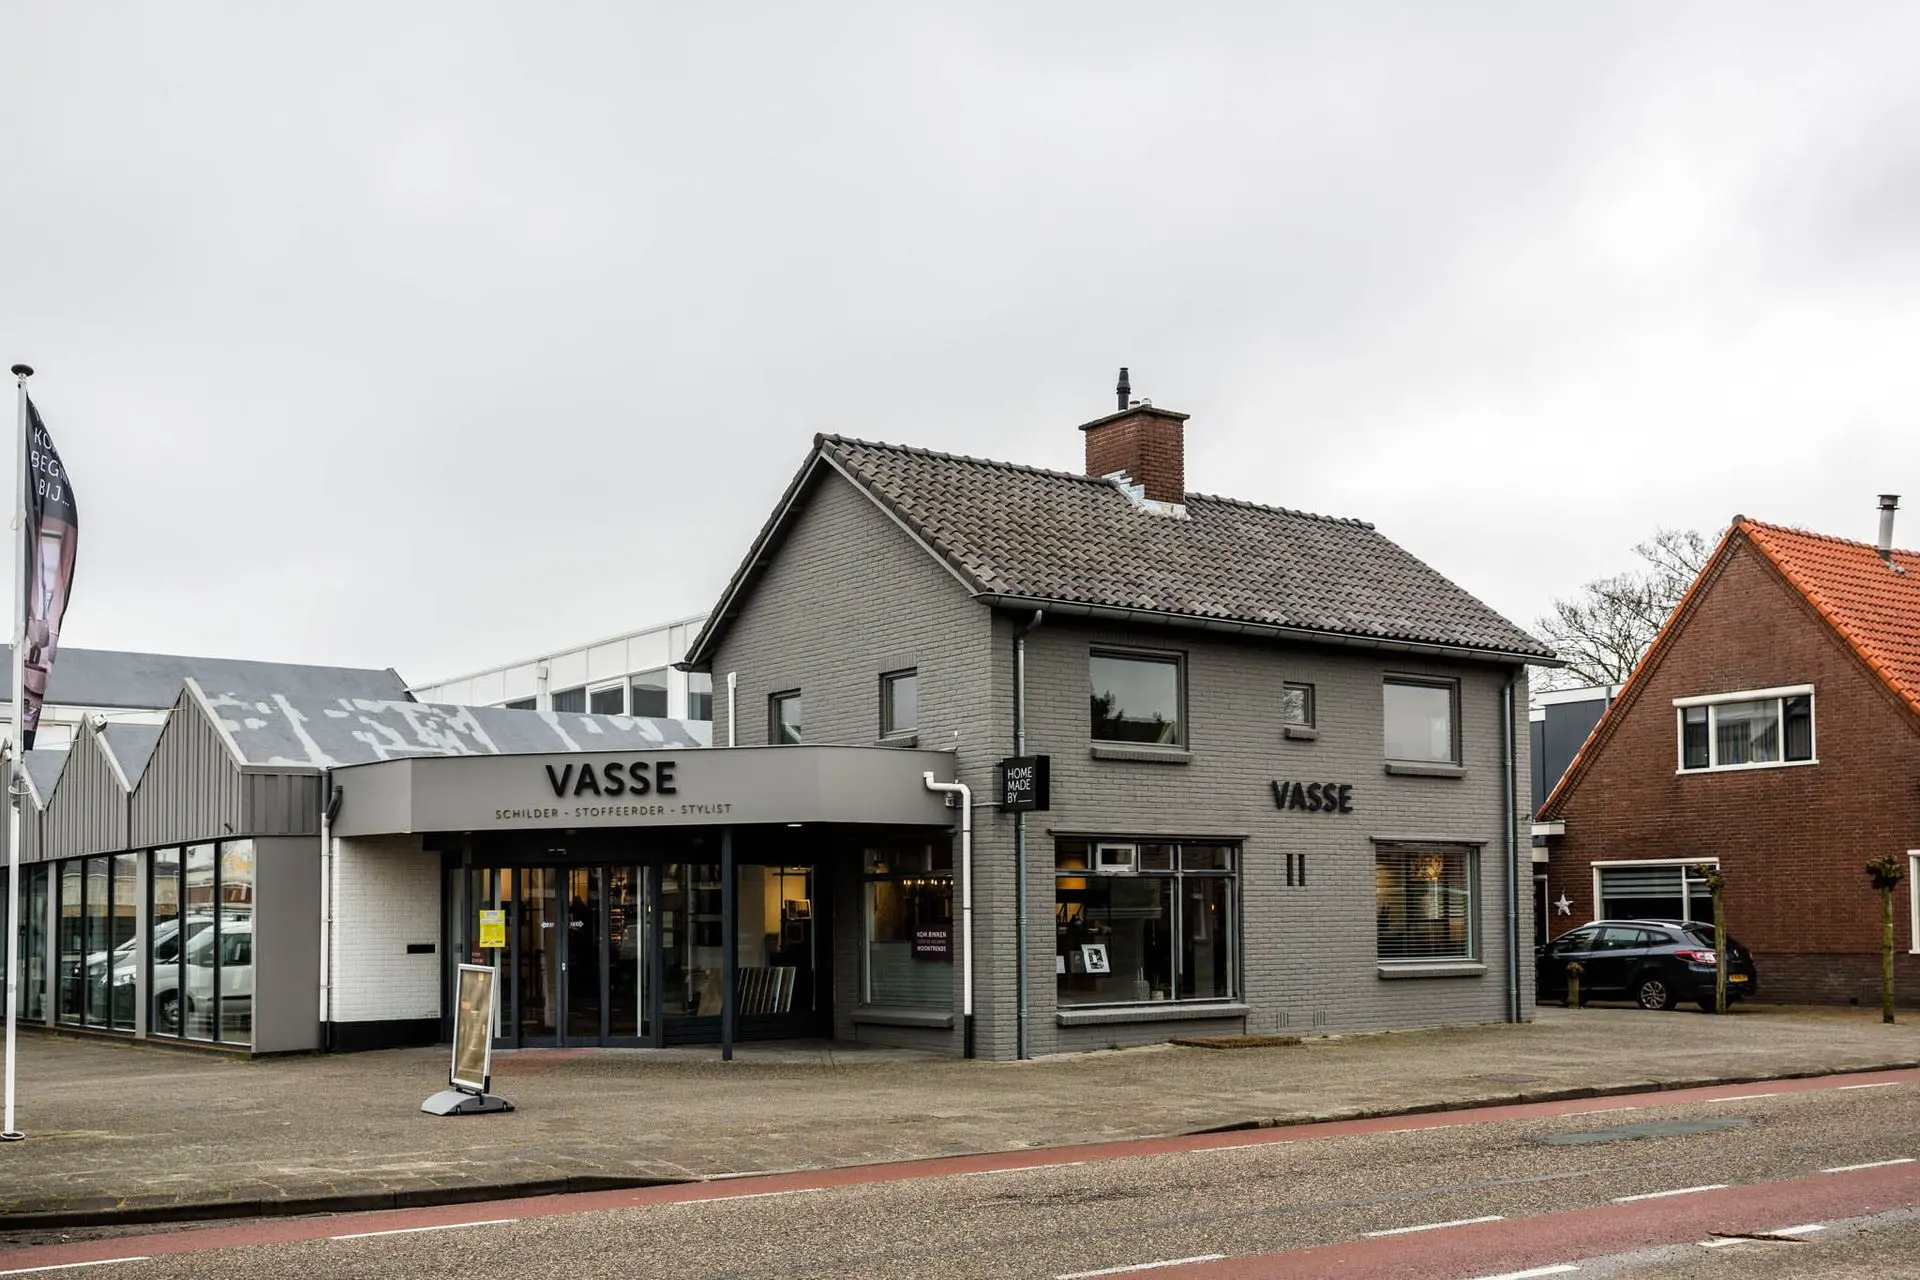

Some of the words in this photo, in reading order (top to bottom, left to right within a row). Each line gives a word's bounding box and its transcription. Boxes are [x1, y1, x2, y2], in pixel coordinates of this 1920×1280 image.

[545, 761, 677, 798] VASSE
[1007, 766, 1033, 780] HOME
[1007, 778, 1031, 792] MADE
[1271, 780, 1354, 813] VASSE
[495, 808, 559, 820] SCHILDER
[575, 805, 665, 818] STOFFEERDER
[680, 803, 732, 815] STYLIST
